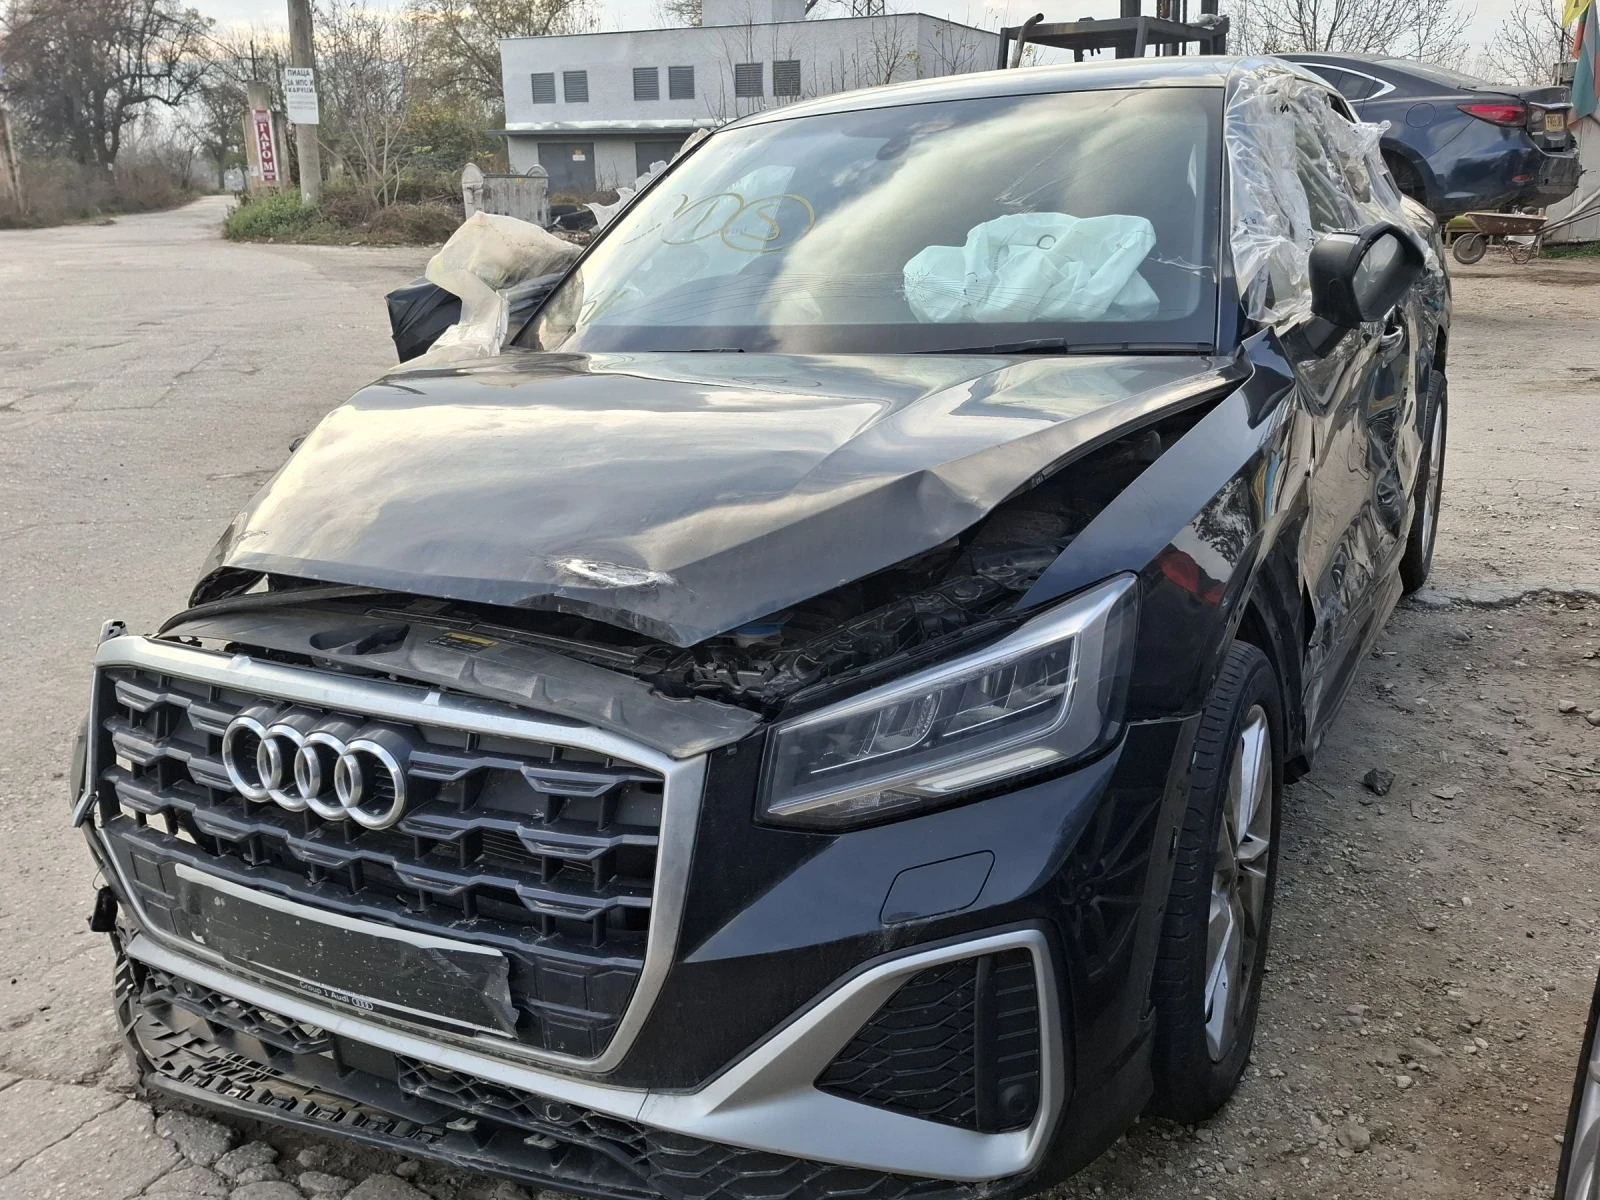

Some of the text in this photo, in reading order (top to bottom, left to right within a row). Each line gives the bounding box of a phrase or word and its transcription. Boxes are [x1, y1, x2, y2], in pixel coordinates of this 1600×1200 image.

[299, 981, 350, 1003] Group 1 Audi
